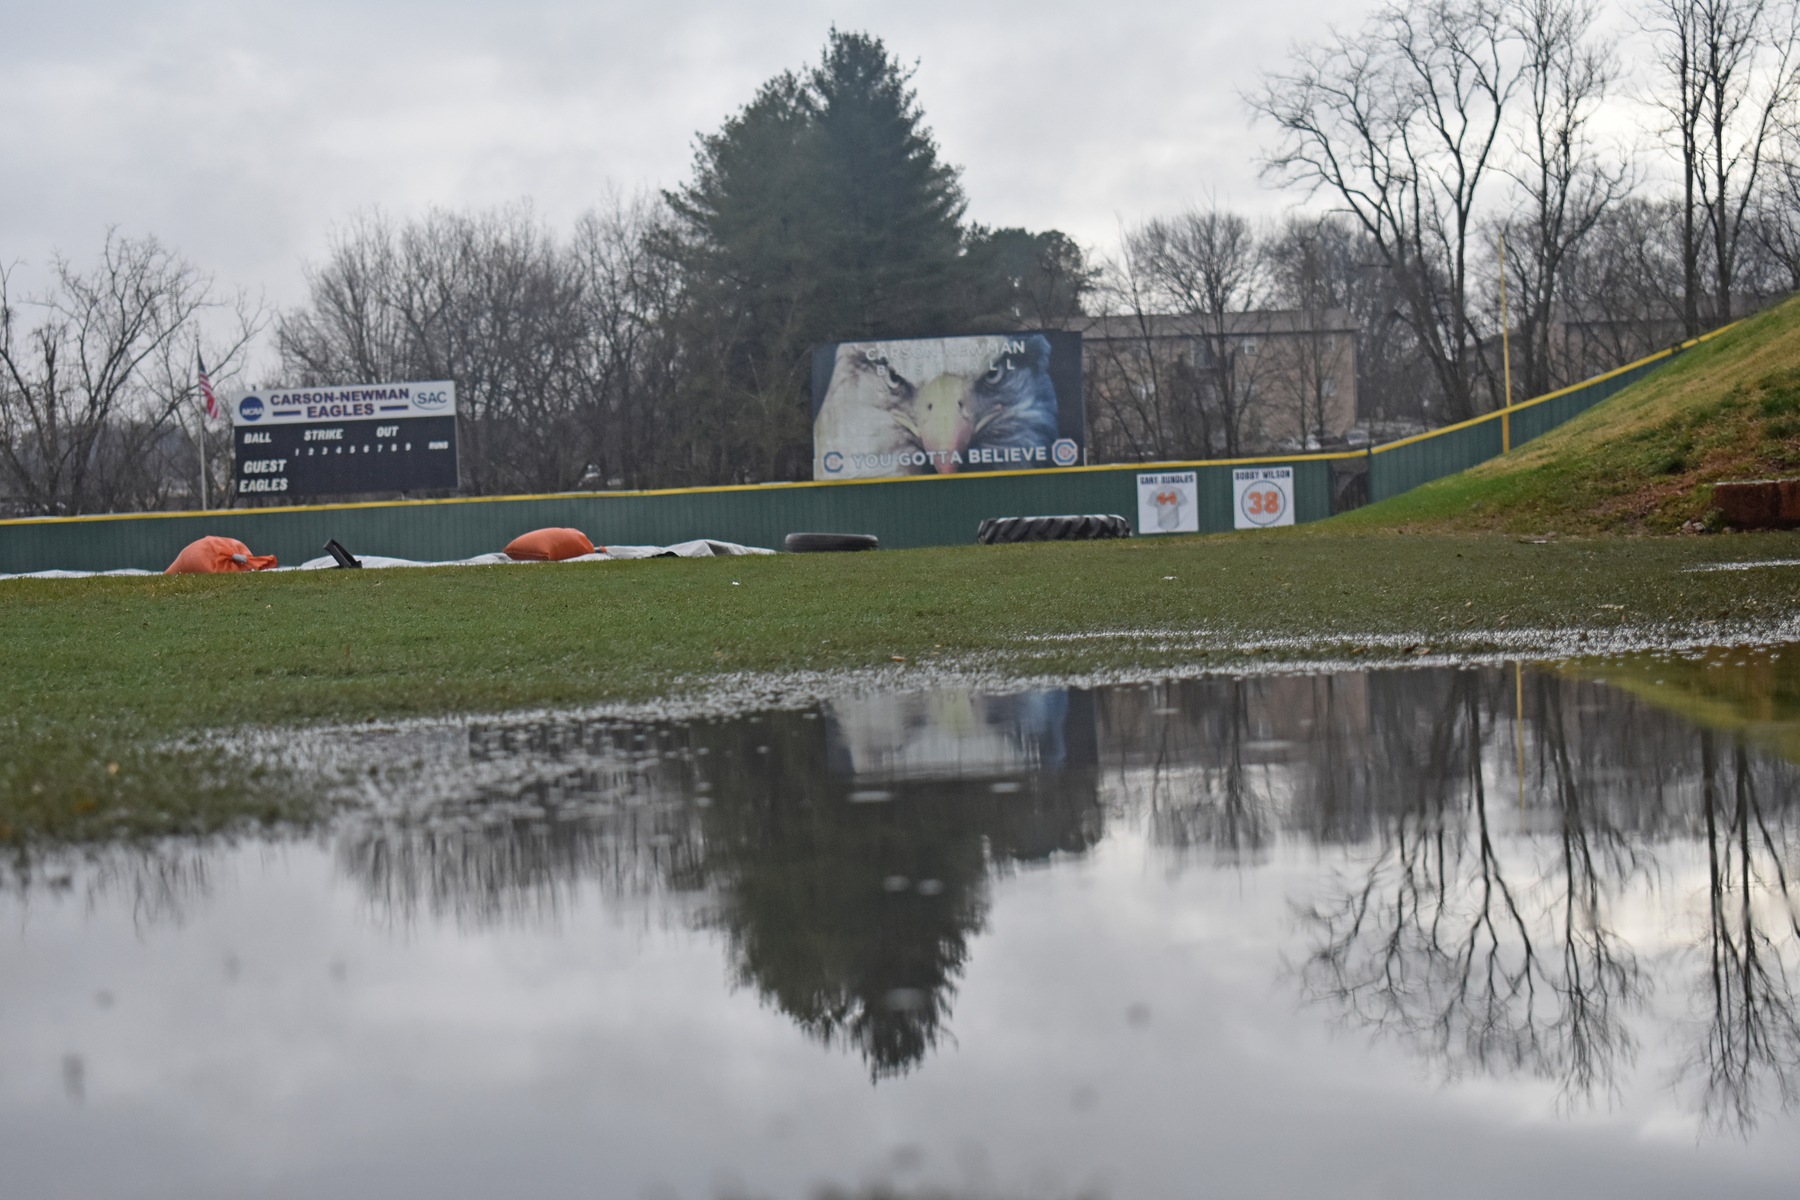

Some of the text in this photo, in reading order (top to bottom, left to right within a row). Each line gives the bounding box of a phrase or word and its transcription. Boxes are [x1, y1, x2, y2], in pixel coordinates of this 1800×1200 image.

[270, 388, 410, 406] CARSON-NEWMAN
[417, 391, 447, 404] SAC
[307, 403, 375, 418] EAGLES
[244, 426, 399, 444] BALL STRIKE OUT
[377, 444, 383, 452] 7
[428, 441, 449, 450] RUNS
[852, 446, 1047, 469] YOU GOTTA BELIEVE
[243, 459, 287, 474] GUEST
[1262, 470, 1290, 479] WILSON
[239, 478, 288, 493] EAGLES
[1248, 491, 1279, 514] 38
